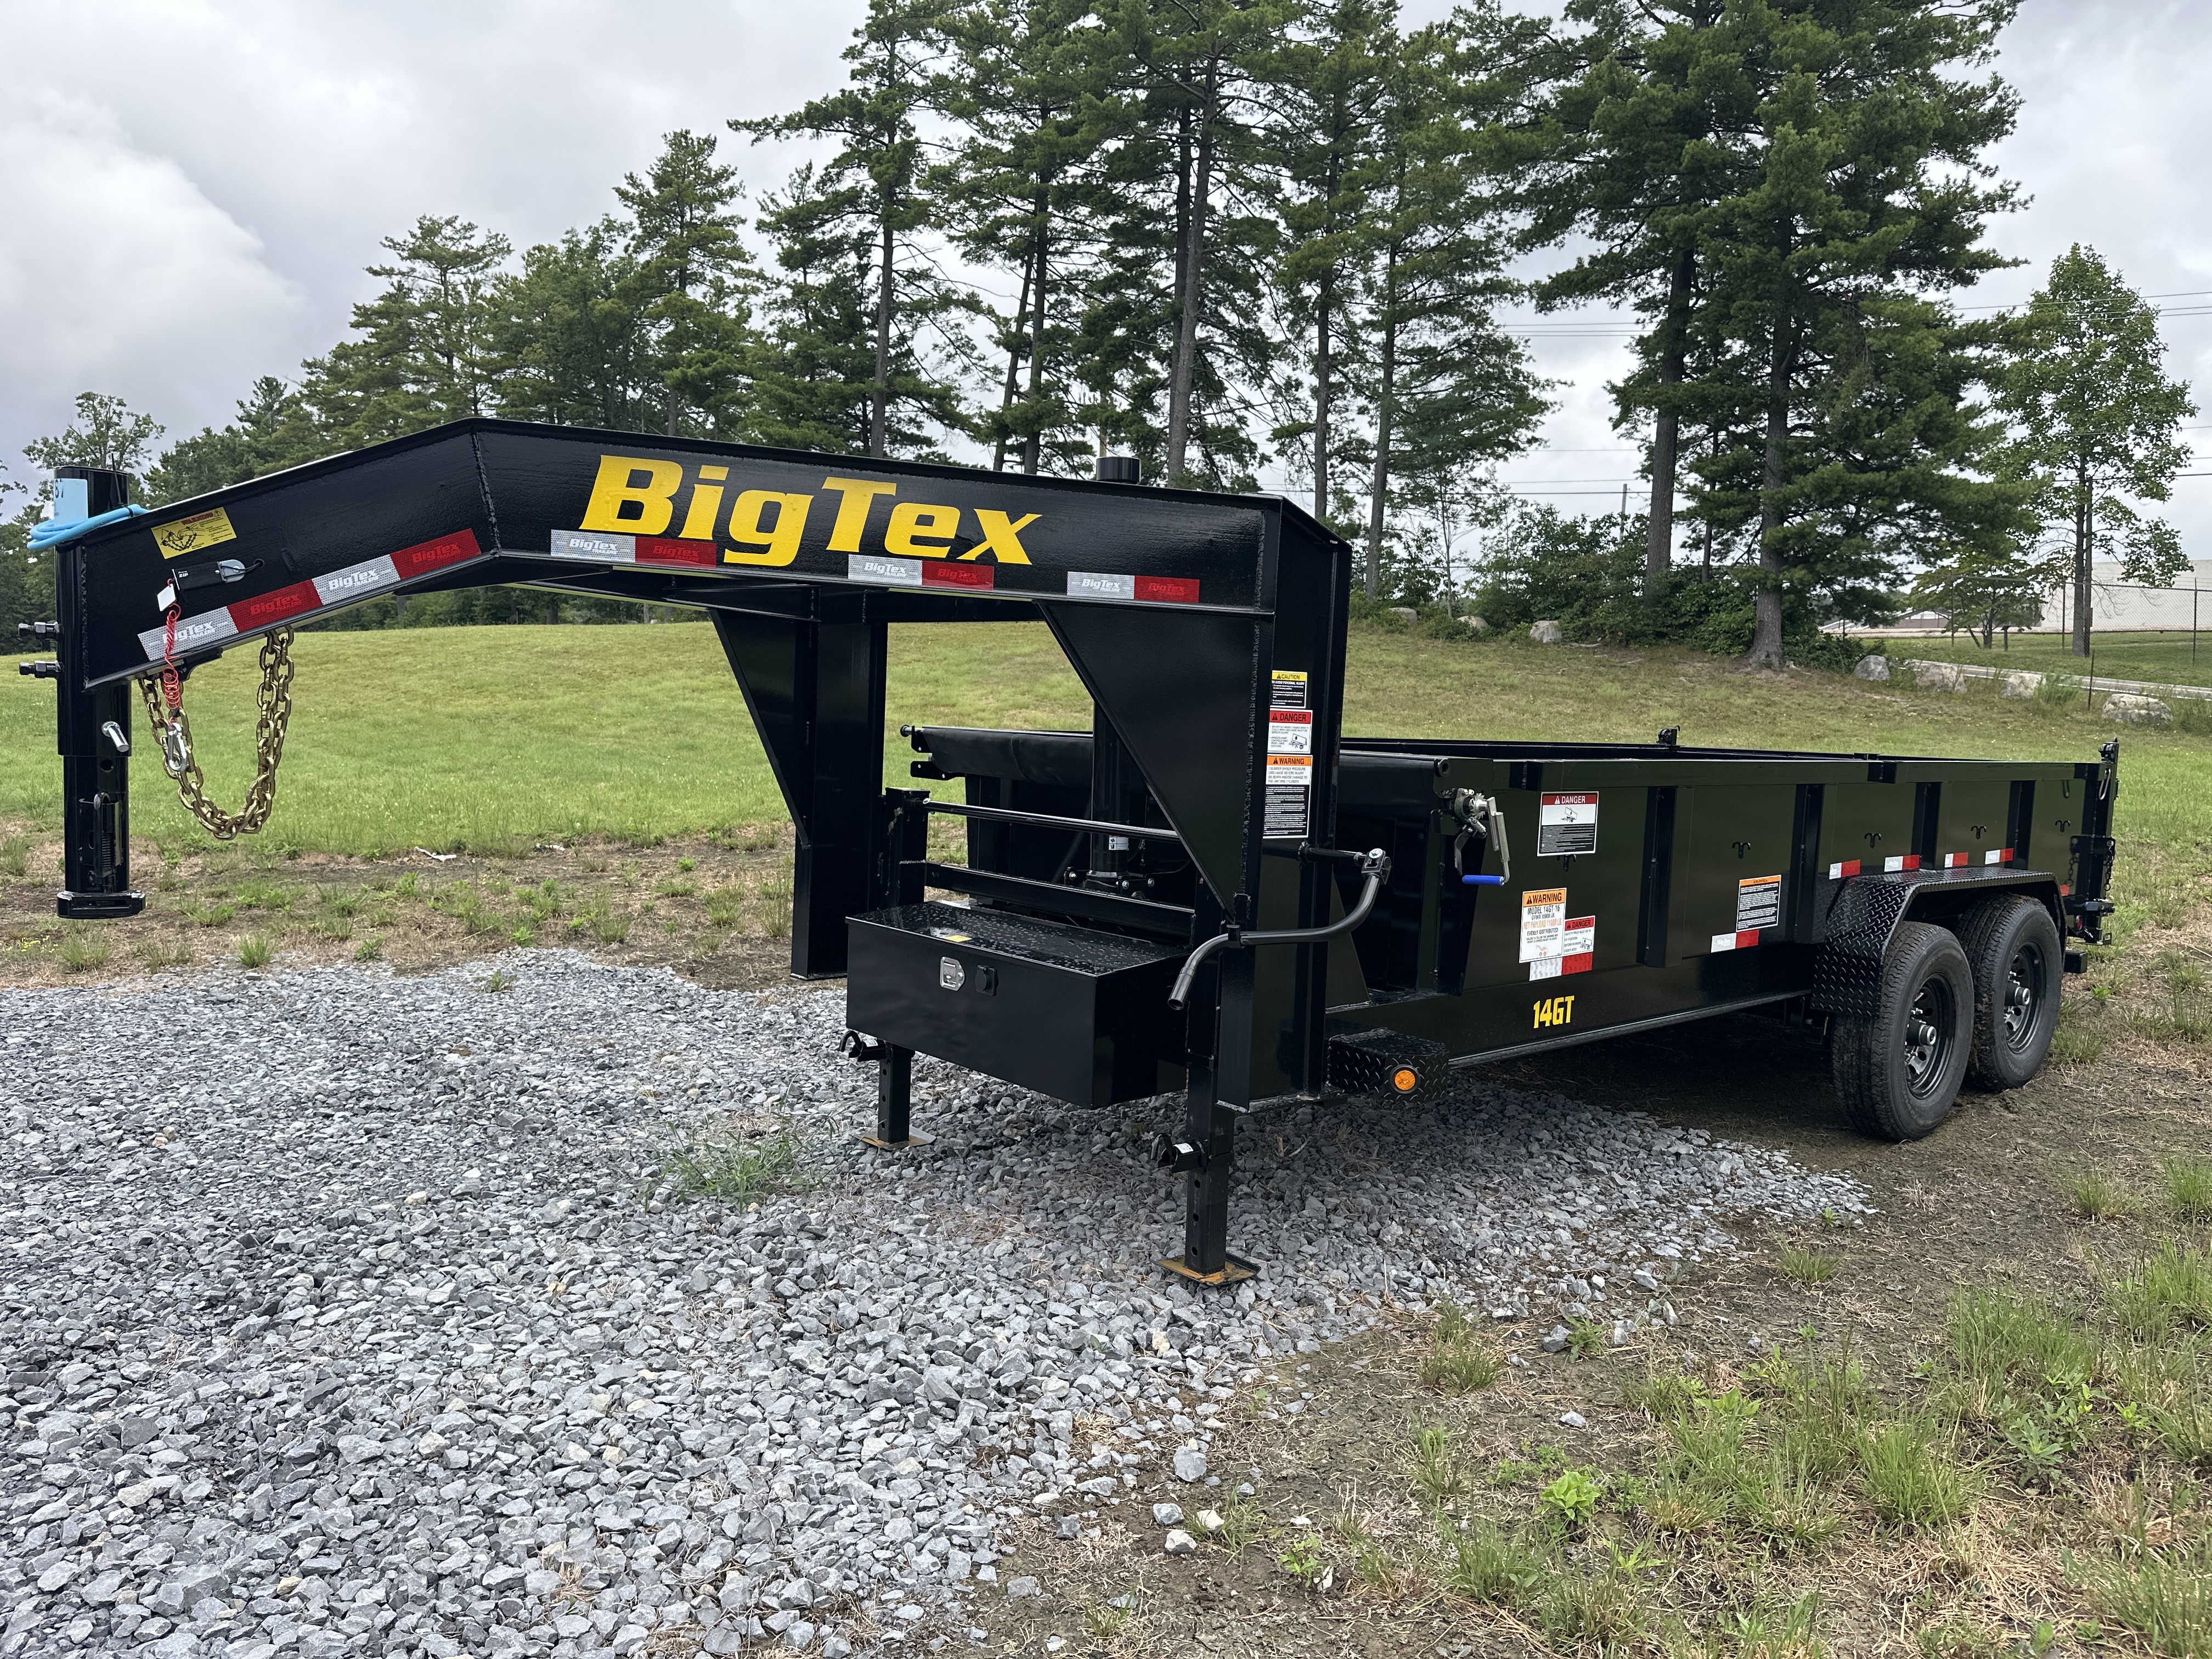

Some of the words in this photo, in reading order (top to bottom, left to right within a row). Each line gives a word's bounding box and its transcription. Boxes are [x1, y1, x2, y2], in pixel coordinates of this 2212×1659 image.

[579, 454, 1042, 567] BigTex
[569, 538, 618, 551] BigTex
[413, 543, 460, 563] BigTex
[653, 545, 700, 557] BigTex
[864, 562, 907, 574] BigTex
[938, 568, 978, 579] BigTex
[329, 569, 379, 590] BigTex
[1082, 579, 1120, 589] BigTex
[1148, 583, 1185, 593] BigTex
[250, 594, 301, 615] BigTex
[1279, 713, 1306, 721] DANGER
[1533, 892, 1562, 904] WARNING
[1528, 906, 1542, 915] MODEL
[1531, 920, 1545, 929] PAYLOAD
[1572, 919, 1591, 928] DANGER
[1533, 996, 1575, 1028] 14GT
